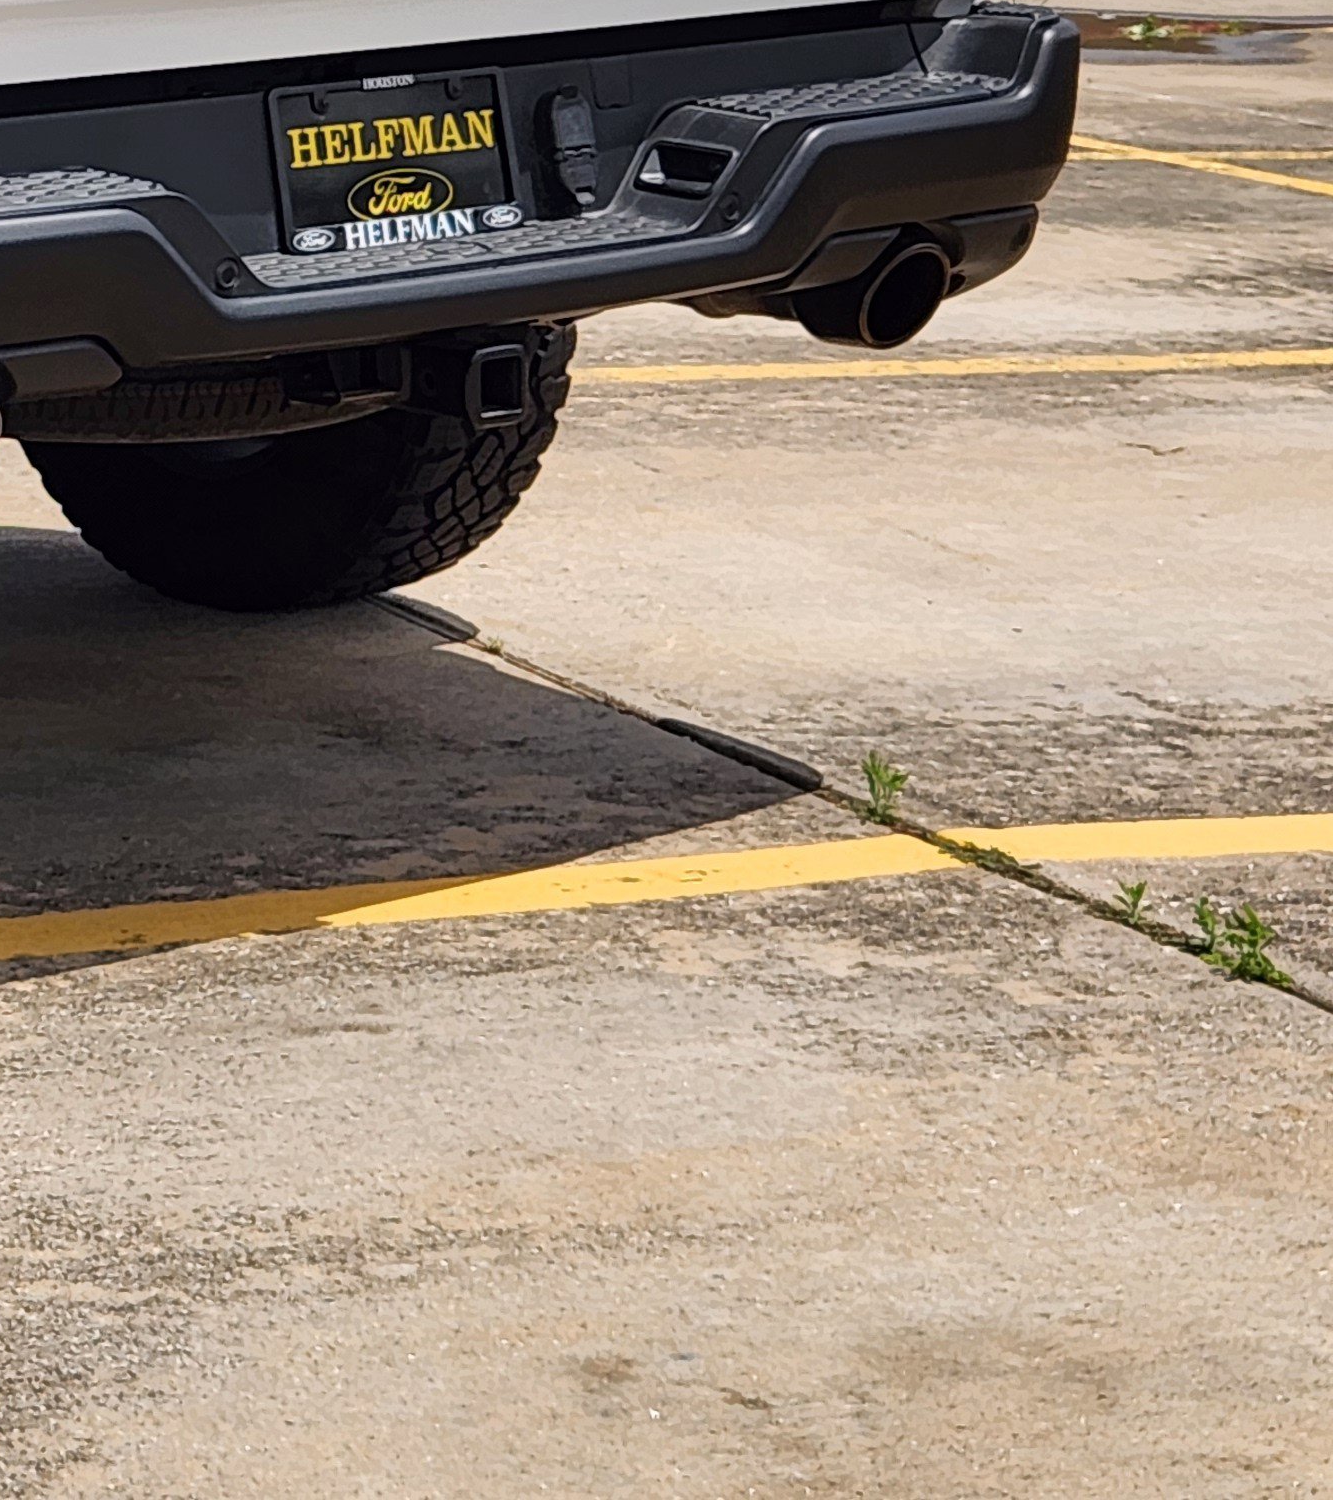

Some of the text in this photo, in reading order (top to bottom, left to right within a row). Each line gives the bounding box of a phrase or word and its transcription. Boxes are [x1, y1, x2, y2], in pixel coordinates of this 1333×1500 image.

[286, 108, 496, 169] HELFMAN
[368, 175, 432, 216] Ford
[342, 207, 477, 250] HELFMAN
